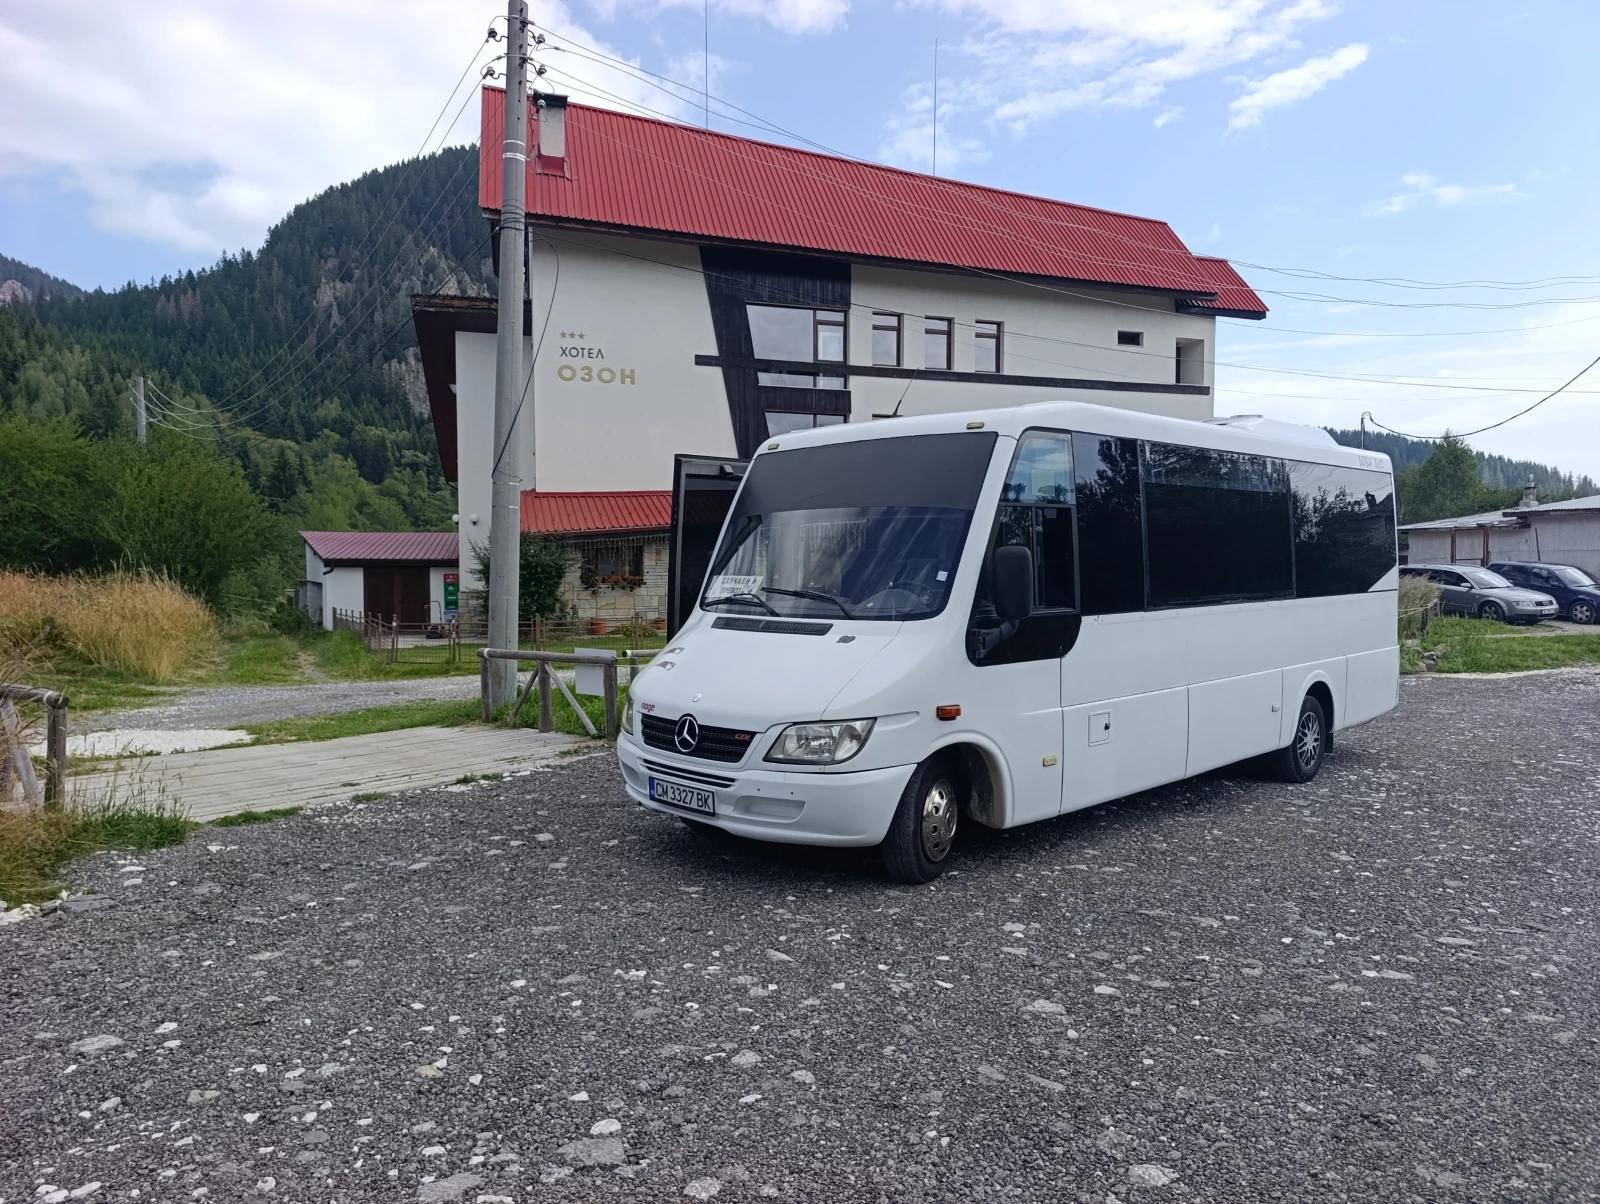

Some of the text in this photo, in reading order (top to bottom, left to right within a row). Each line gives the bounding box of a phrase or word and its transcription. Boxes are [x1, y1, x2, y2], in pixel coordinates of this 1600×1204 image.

[560, 346, 605, 359] ХОТЕЛ
[557, 364, 636, 385] ОЗОН
[655, 782, 711, 810] CM 3327 BK
